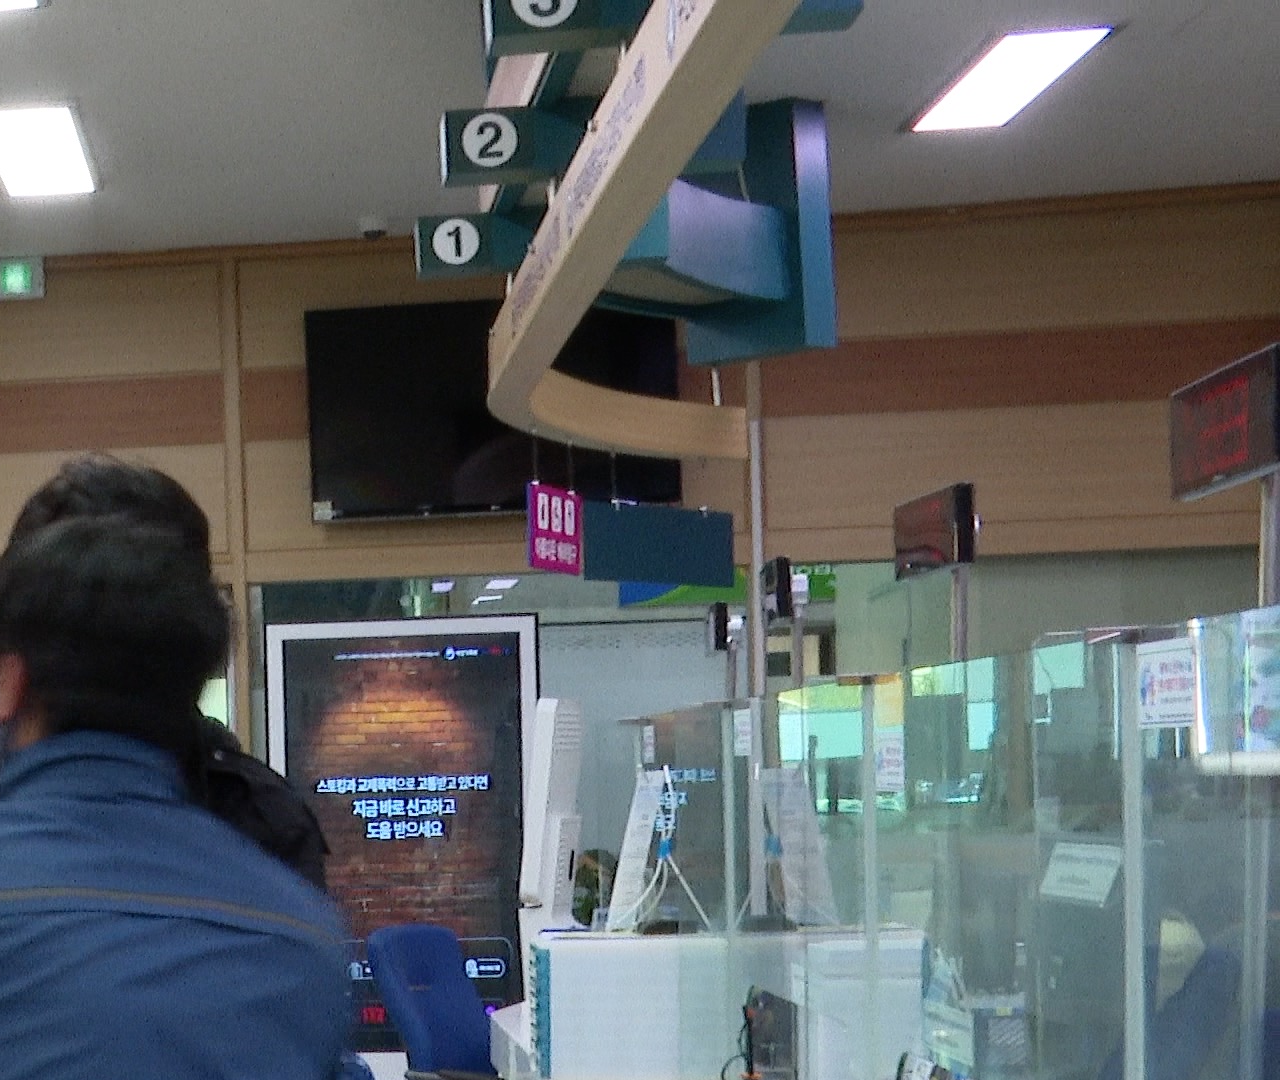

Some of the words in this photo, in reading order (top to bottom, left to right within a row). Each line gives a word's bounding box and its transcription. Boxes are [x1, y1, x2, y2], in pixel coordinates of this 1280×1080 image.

[477, 121, 503, 159] 2
[447, 226, 462, 257] 1
[352, 799, 379, 817] 지금
[379, 798, 406, 816] 바로
[406, 798, 456, 817] 신고하고
[366, 821, 392, 839] 도움
[393, 820, 443, 839] 받으세요
